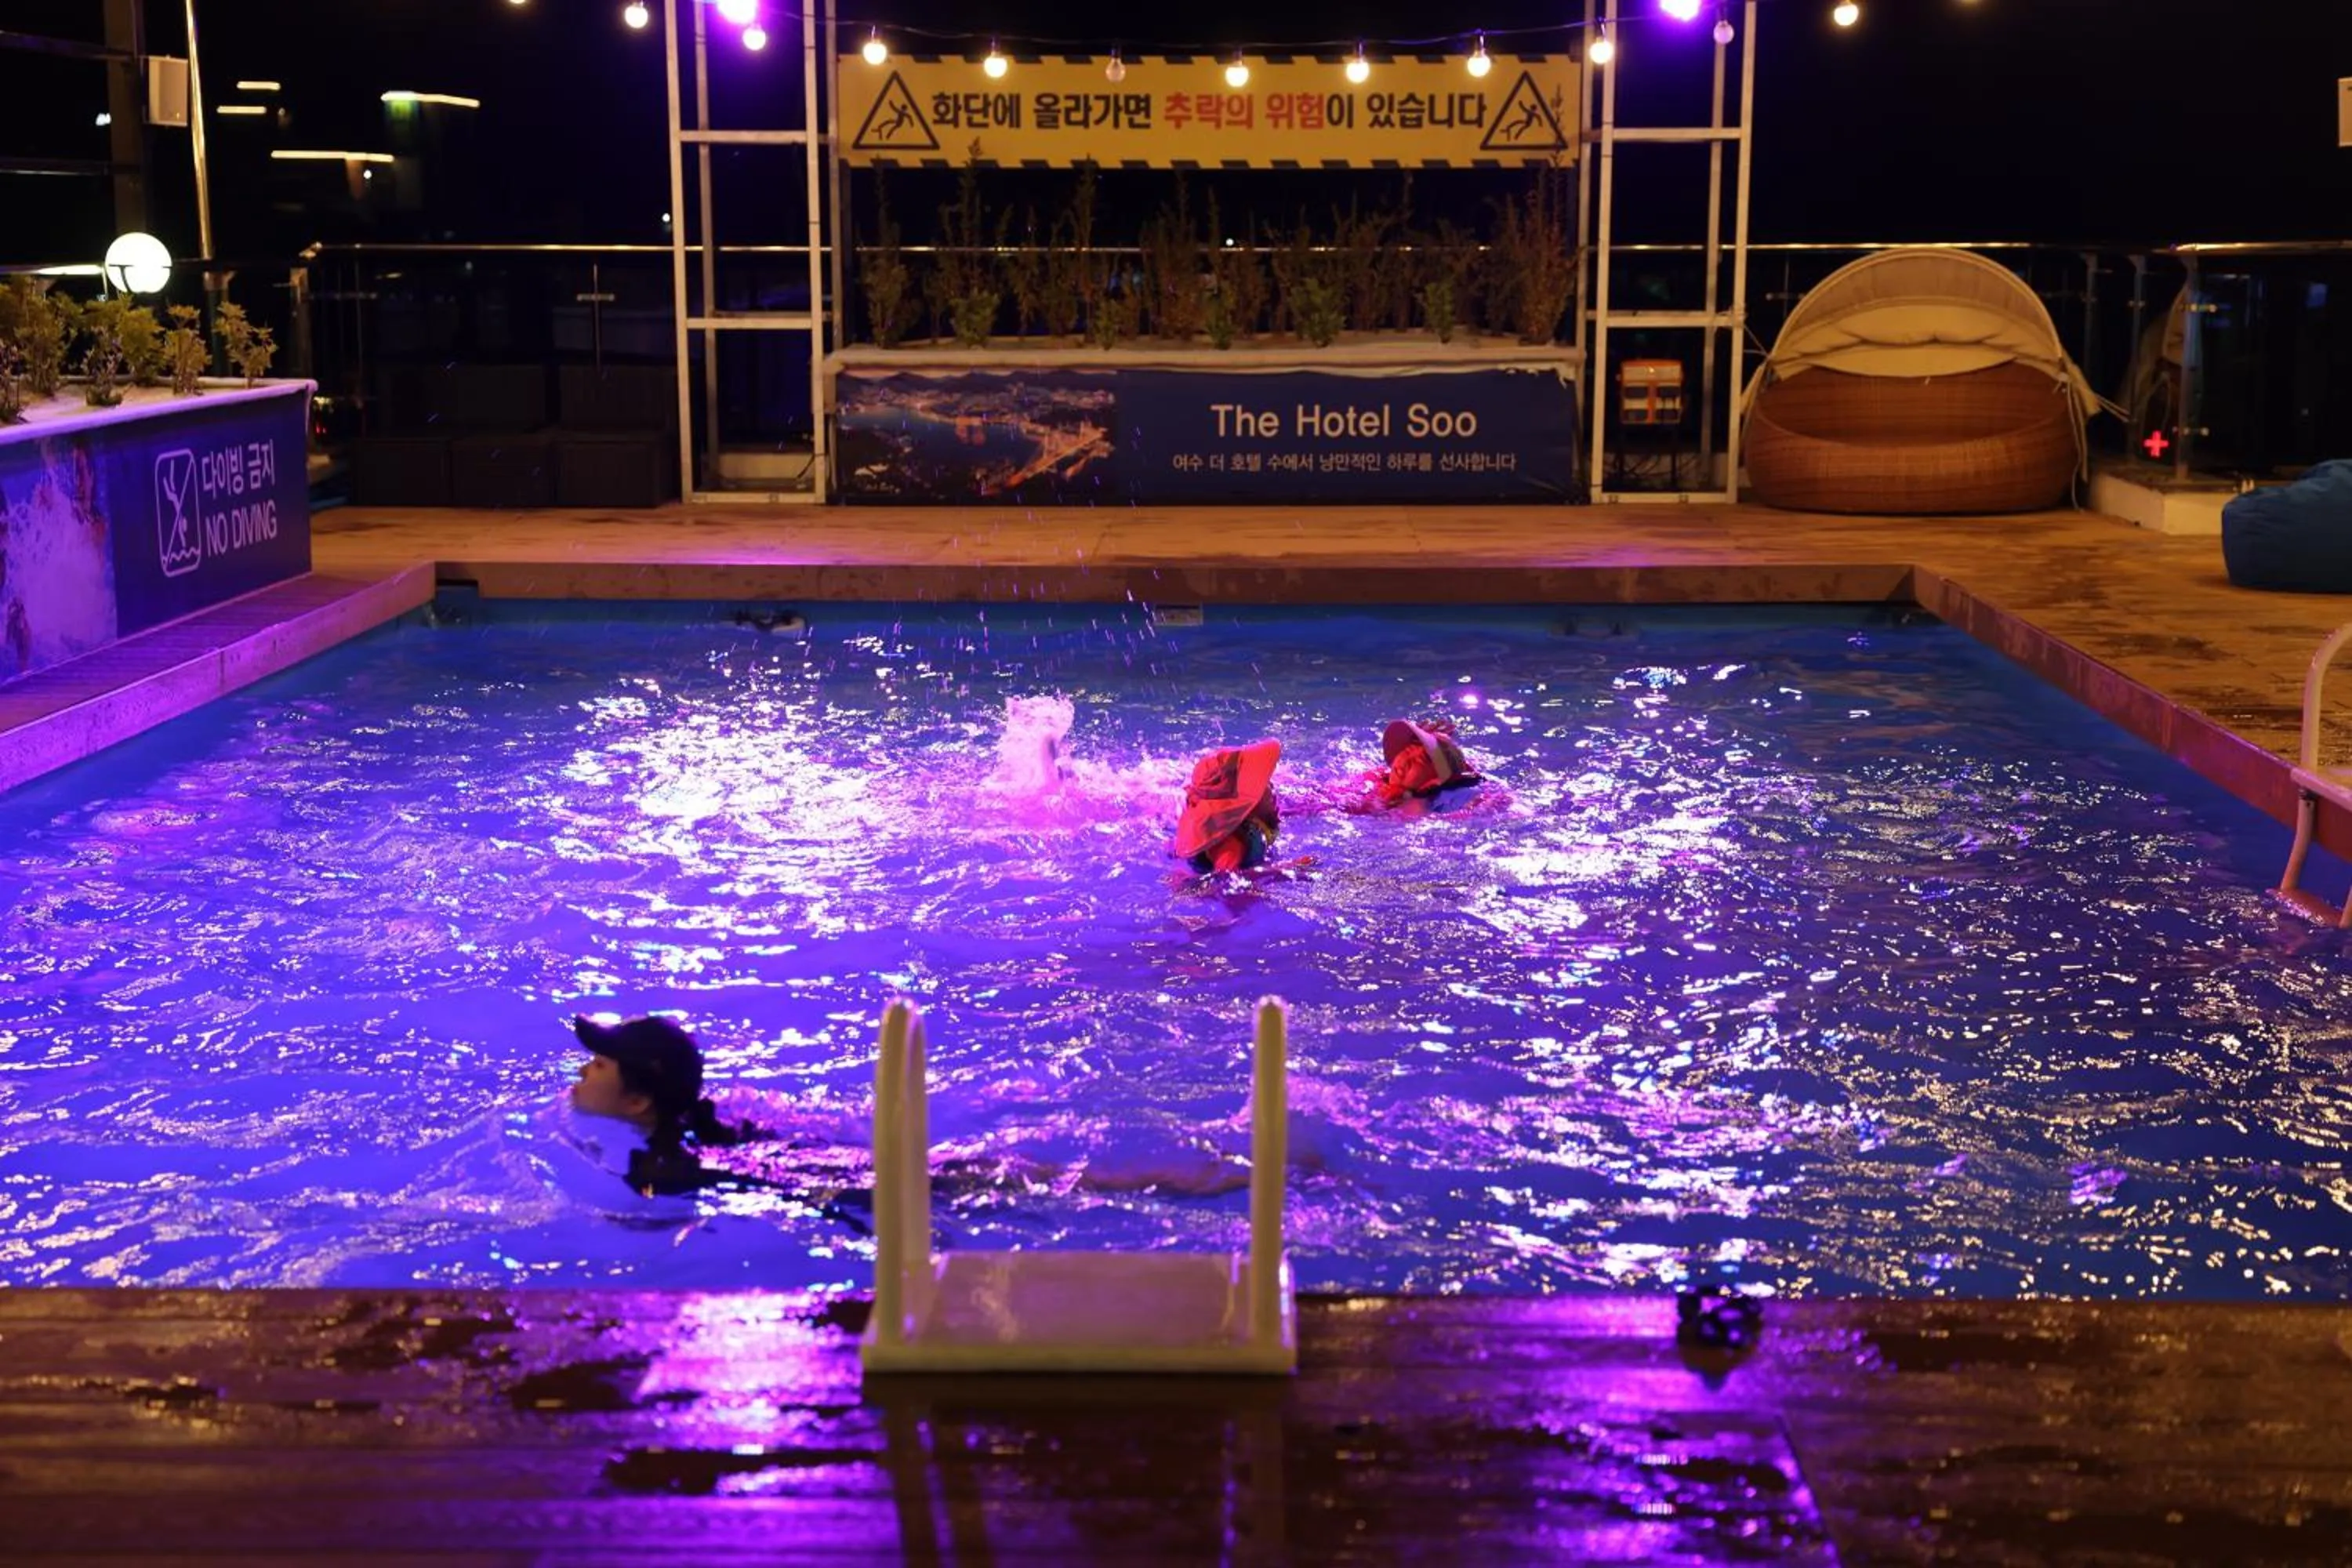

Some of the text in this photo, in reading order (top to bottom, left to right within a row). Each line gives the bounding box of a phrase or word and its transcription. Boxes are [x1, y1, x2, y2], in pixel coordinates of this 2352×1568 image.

[931, 91, 1487, 130] 화단에 올라가면 추락의 위험이 있습니다
[1210, 403, 1478, 437] The Hotel Soo
[201, 438, 275, 499] 다이빙 금지
[1173, 453, 1204, 471] 여수
[1210, 453, 1225, 471] 더
[1267, 453, 1314, 471] 수에서
[1319, 453, 1381, 472] 낭만적인
[1387, 452, 1432, 471] 하루를
[1439, 452, 1517, 471] 선사합니다
[205, 499, 277, 557] NO DIVING
